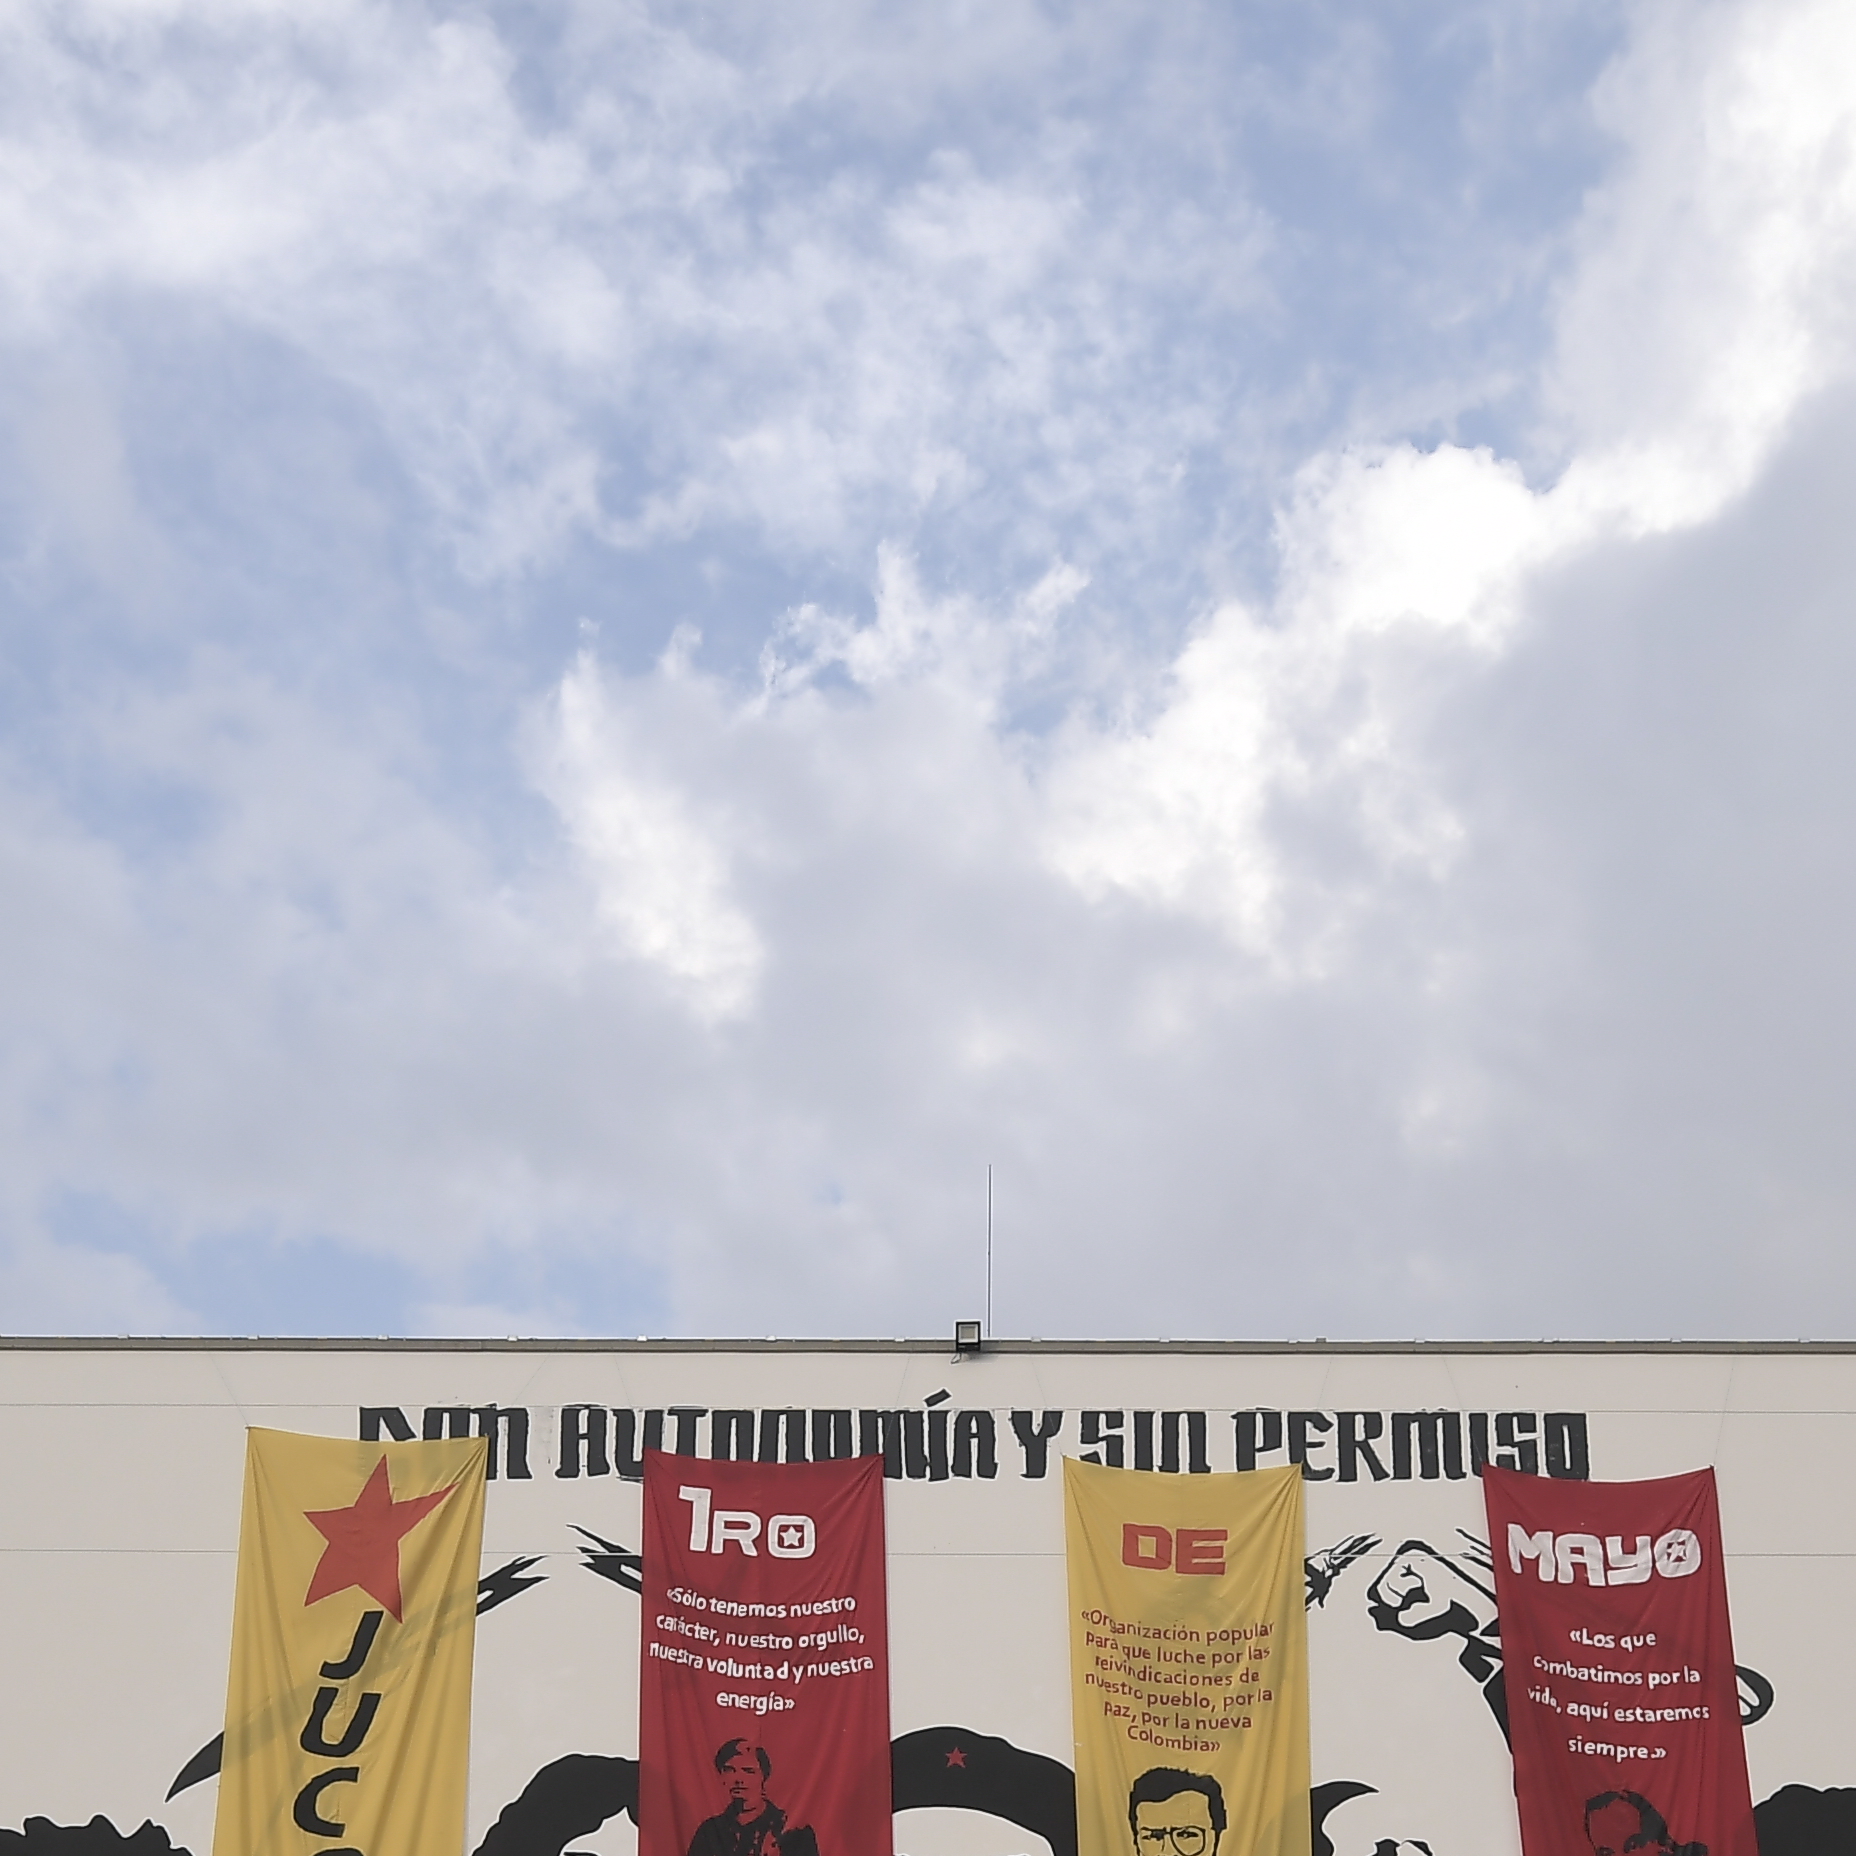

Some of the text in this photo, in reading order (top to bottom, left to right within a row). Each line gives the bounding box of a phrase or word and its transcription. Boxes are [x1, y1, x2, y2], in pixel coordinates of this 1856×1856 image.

[1010, 1410, 1063, 1479] Y
[1079, 1411, 1211, 1473] SIN
[1231, 1410, 1590, 1481] PERMISO
[678, 1485, 816, 1558] 1RO
[1122, 1523, 1228, 1575] DE
[1507, 1523, 1701, 1586] MAYO
[709, 1598, 787, 1618] tenemos
[790, 1597, 856, 1617] nuestro
[656, 1614, 865, 1651] carácter, nuestro orgullo,
[1081, 1610, 1275, 1646] «Organización popular
[1570, 1627, 1657, 1652] «Los que
[649, 1642, 874, 1684] nuestra voluntad y nuestra
[1095, 1655, 1259, 1686] reivindicaciones de
[1122, 1644, 1151, 1660] que
[1157, 1647, 1206, 1664] luche
[1211, 1652, 1242, 1668] por
[1248, 1646, 1270, 1660] las
[1533, 1655, 1701, 1689] combatimos por la
[716, 1691, 795, 1715] energía»
[1085, 1672, 1273, 1713] nuestro pueblo, por la
[1141, 1711, 1170, 1727] por
[1175, 1712, 1190, 1730] la
[1195, 1715, 1252, 1730] nueva
[1566, 1702, 1609, 1722] aquí
[1614, 1706, 1710, 1723] estaremos
[1127, 1725, 1221, 1752] Colombia»
